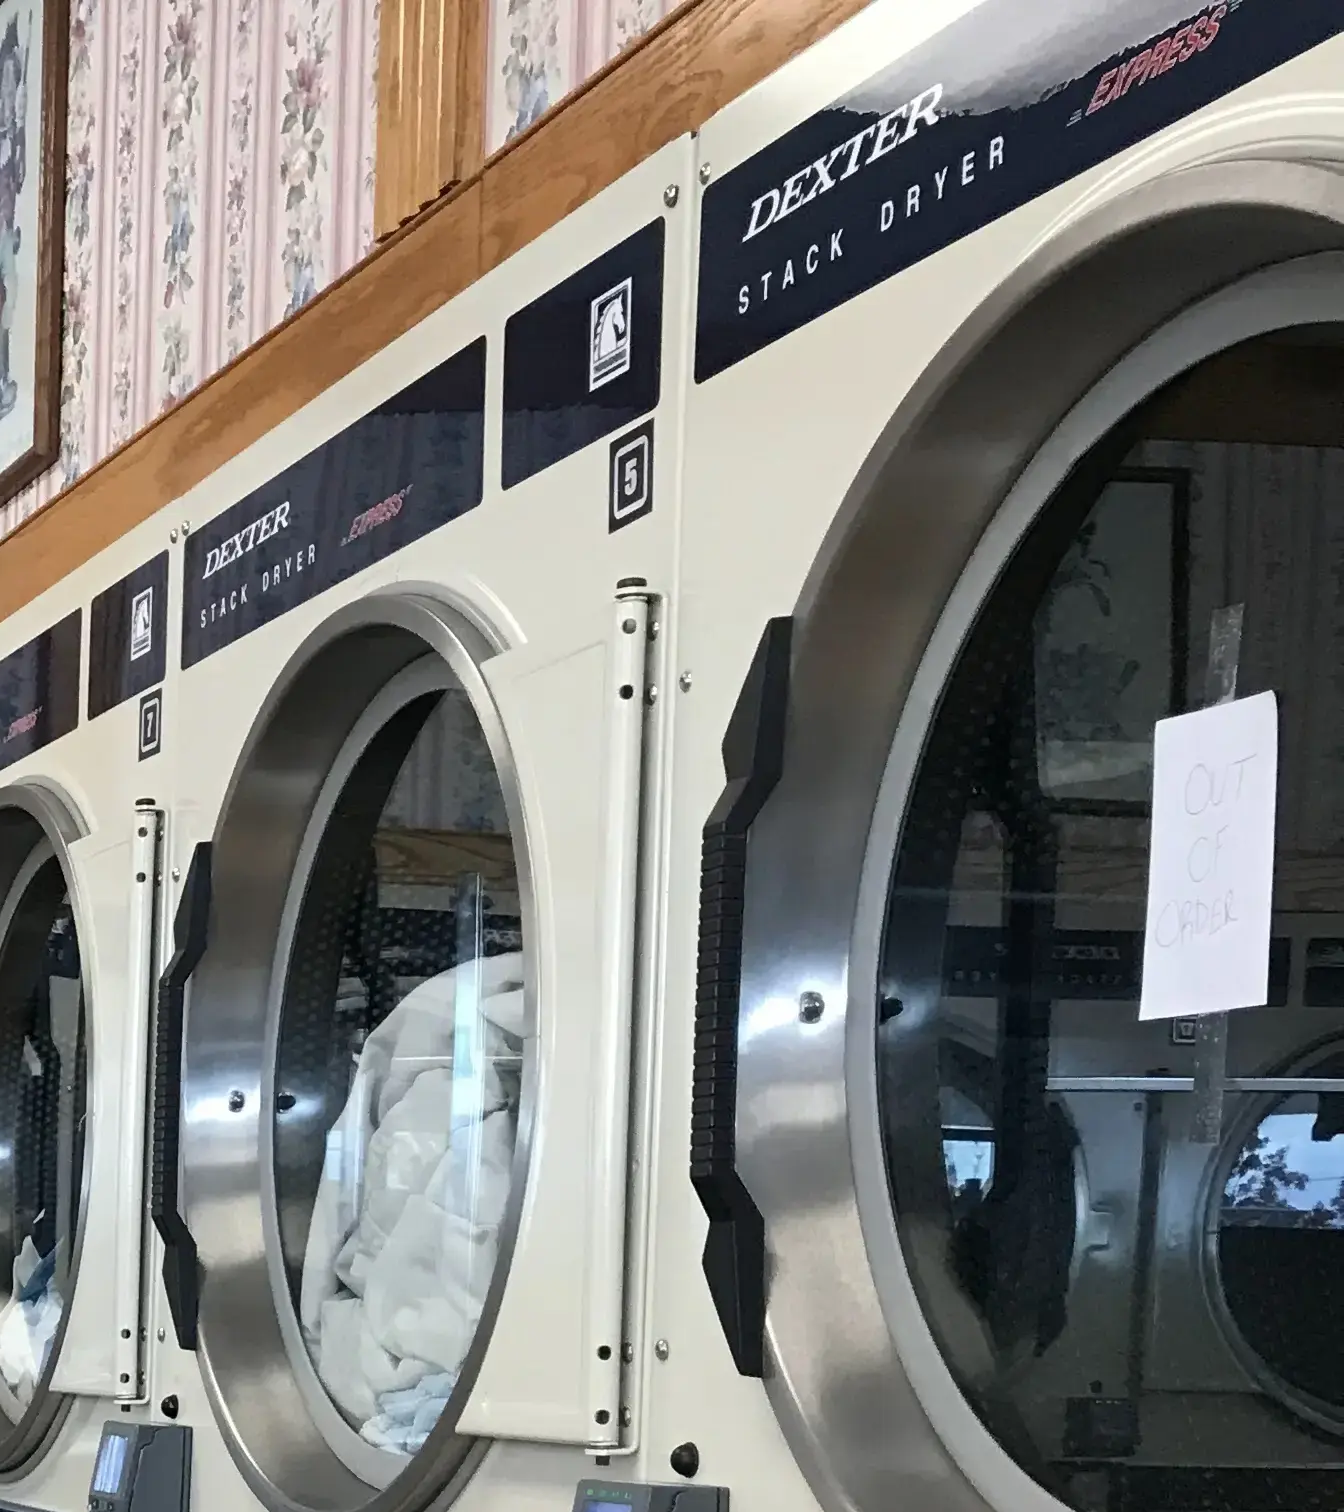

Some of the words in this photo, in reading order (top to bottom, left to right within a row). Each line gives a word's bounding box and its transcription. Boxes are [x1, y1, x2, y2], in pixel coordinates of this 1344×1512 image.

[1085, 4, 1228, 116] EXPRESS
[742, 83, 945, 243] DEXTER
[737, 227, 845, 315] STACK
[880, 134, 1005, 233] DRYER
[624, 457, 639, 497] 5
[202, 501, 292, 580] DEXTER
[200, 584, 248, 629] STACK
[262, 543, 317, 592] DRYER
[144, 712, 154, 738] 7
[1184, 752, 1258, 816] OUT
[1186, 824, 1230, 883] OF
[1154, 888, 1239, 948] ORDER
